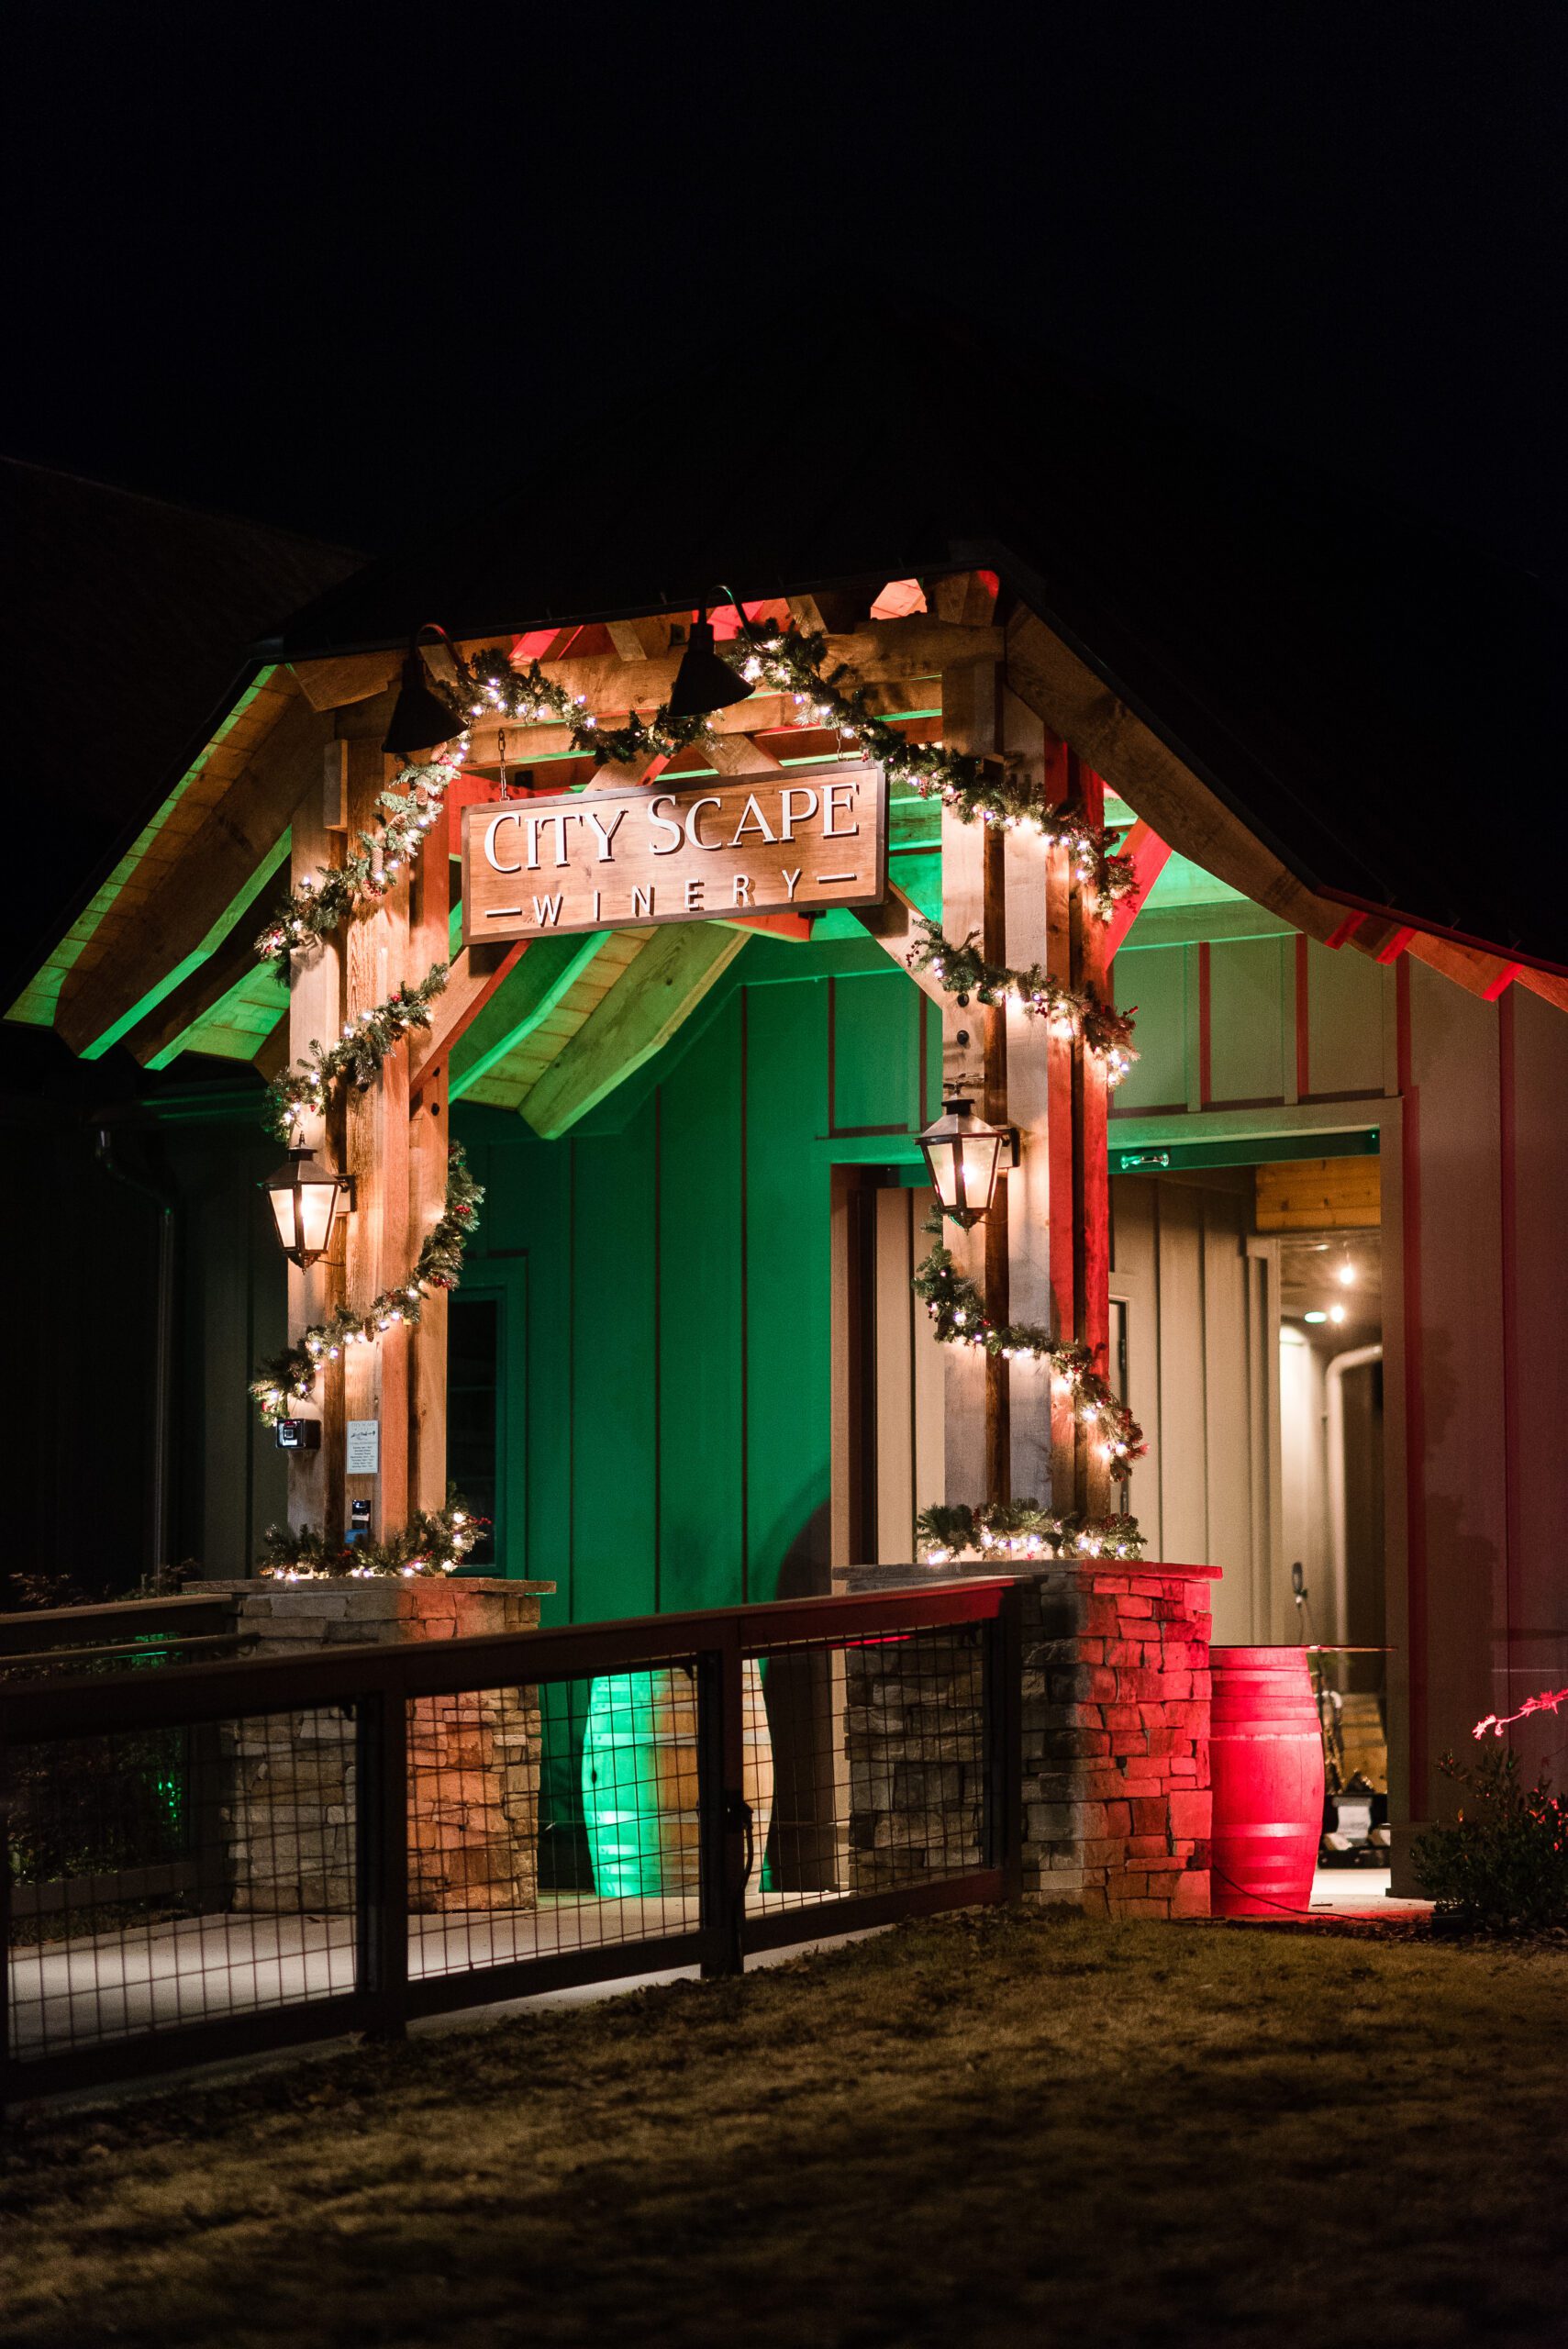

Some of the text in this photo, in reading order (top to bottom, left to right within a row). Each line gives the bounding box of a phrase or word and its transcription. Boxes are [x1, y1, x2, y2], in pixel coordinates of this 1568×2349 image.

[484, 782, 860, 873] CITY SCAPE
[532, 868, 802, 926] WINERY
